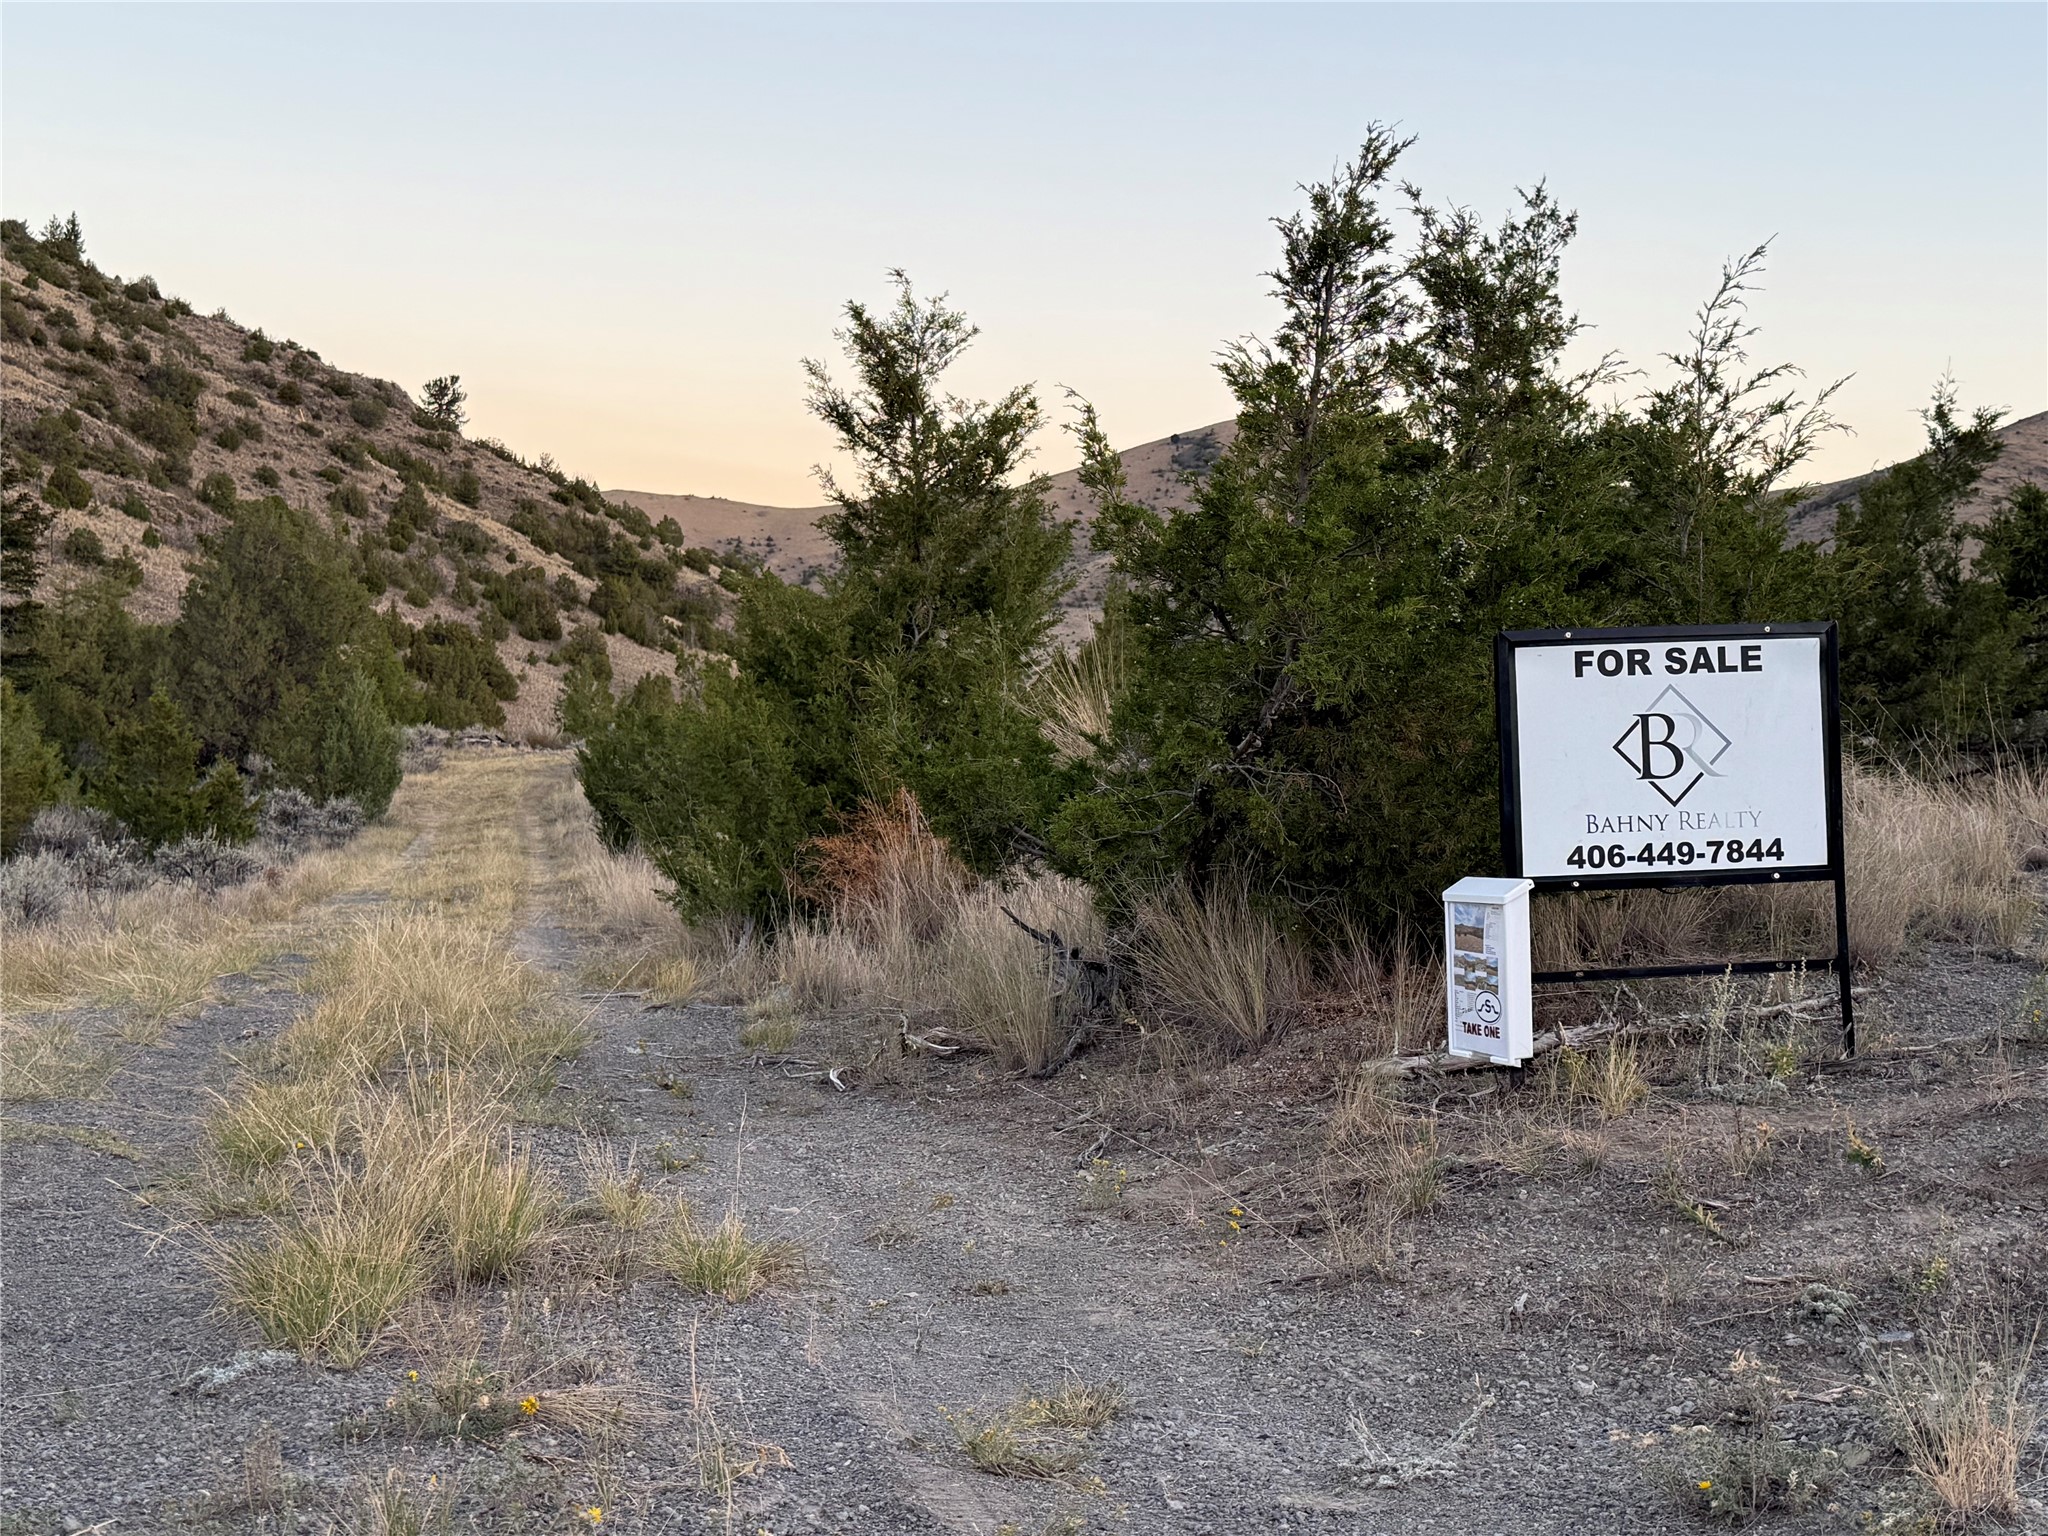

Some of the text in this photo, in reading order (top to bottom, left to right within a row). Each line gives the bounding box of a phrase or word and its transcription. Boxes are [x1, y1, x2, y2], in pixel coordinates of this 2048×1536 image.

[1574, 645, 1762, 678] FOR SALE
[1586, 810, 1762, 834] BAHNY REALTY
[1566, 838, 1785, 869] 406-449-7844
[1462, 1021, 1482, 1036] TAKE
[1484, 1025, 1501, 1039] ONE
